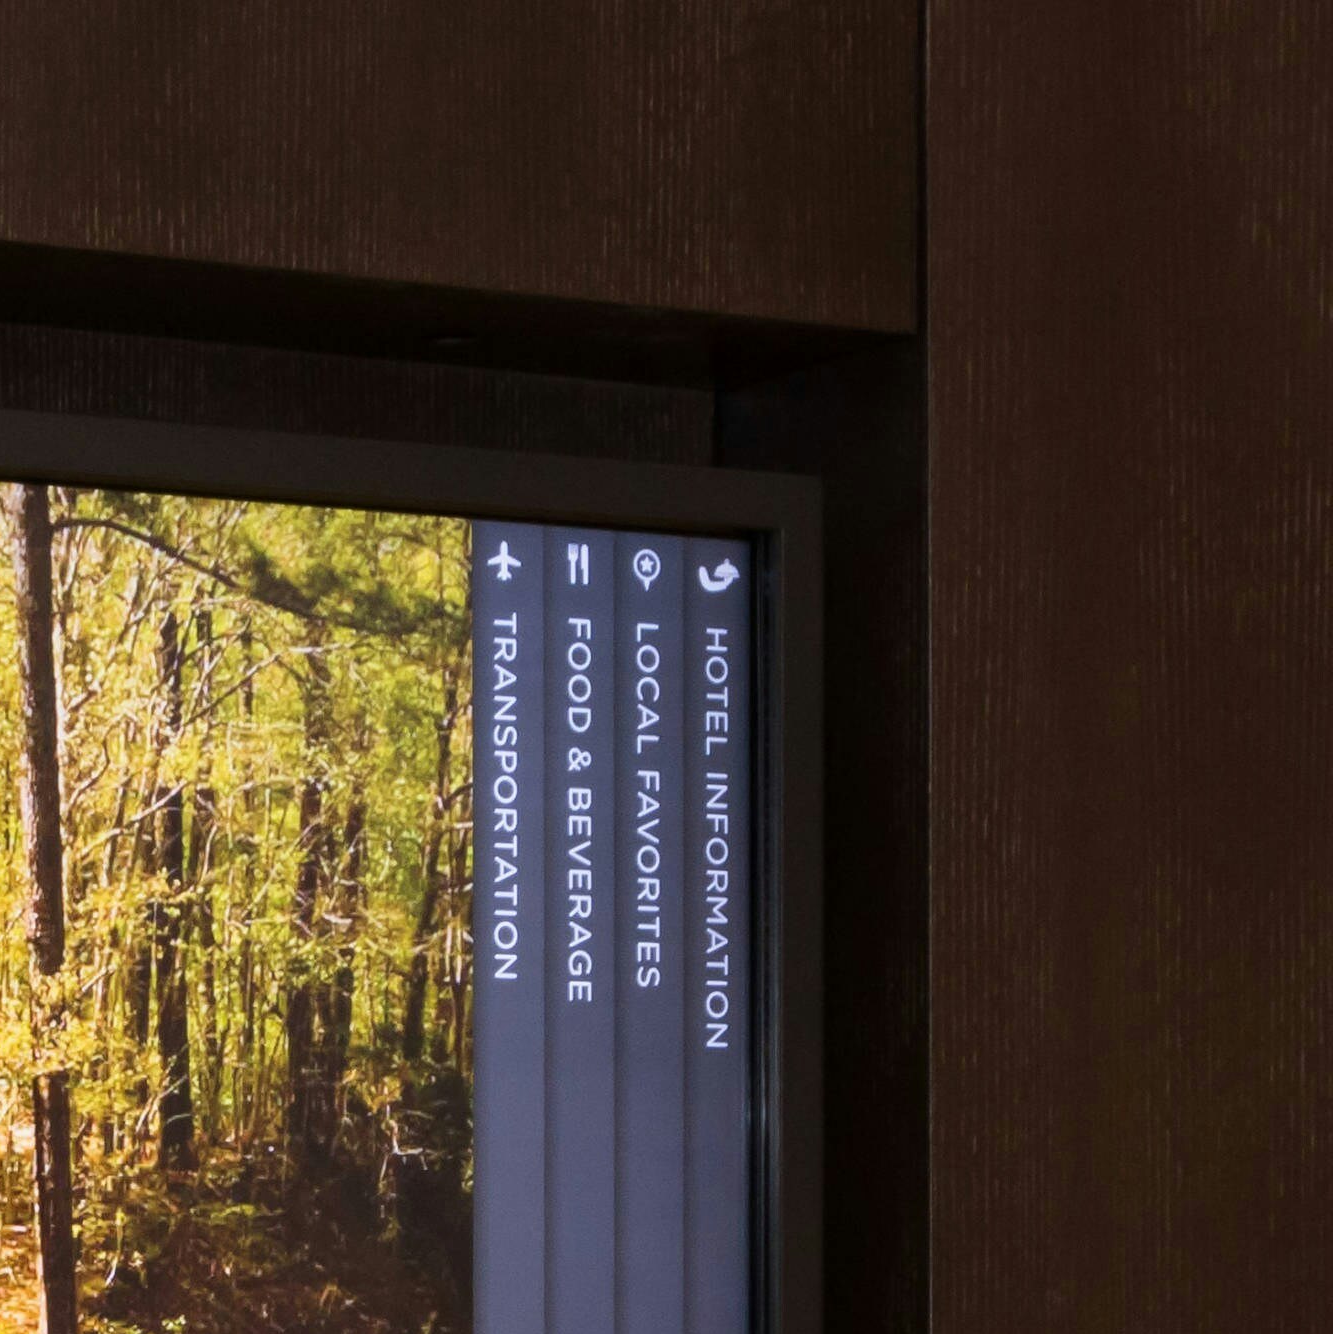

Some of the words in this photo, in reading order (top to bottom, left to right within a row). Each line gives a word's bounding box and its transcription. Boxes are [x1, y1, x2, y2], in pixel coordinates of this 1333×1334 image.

[567, 617, 592, 733] FOOD
[567, 746, 593, 772] &
[635, 622, 661, 755] LOCAL
[704, 627, 729, 756] HOTEL
[493, 612, 519, 980] TRANSPORTATION
[636, 769, 661, 988] FAVORITES
[567, 786, 593, 1003] BEVERAGE
[705, 772, 730, 1049] INFORMATION
